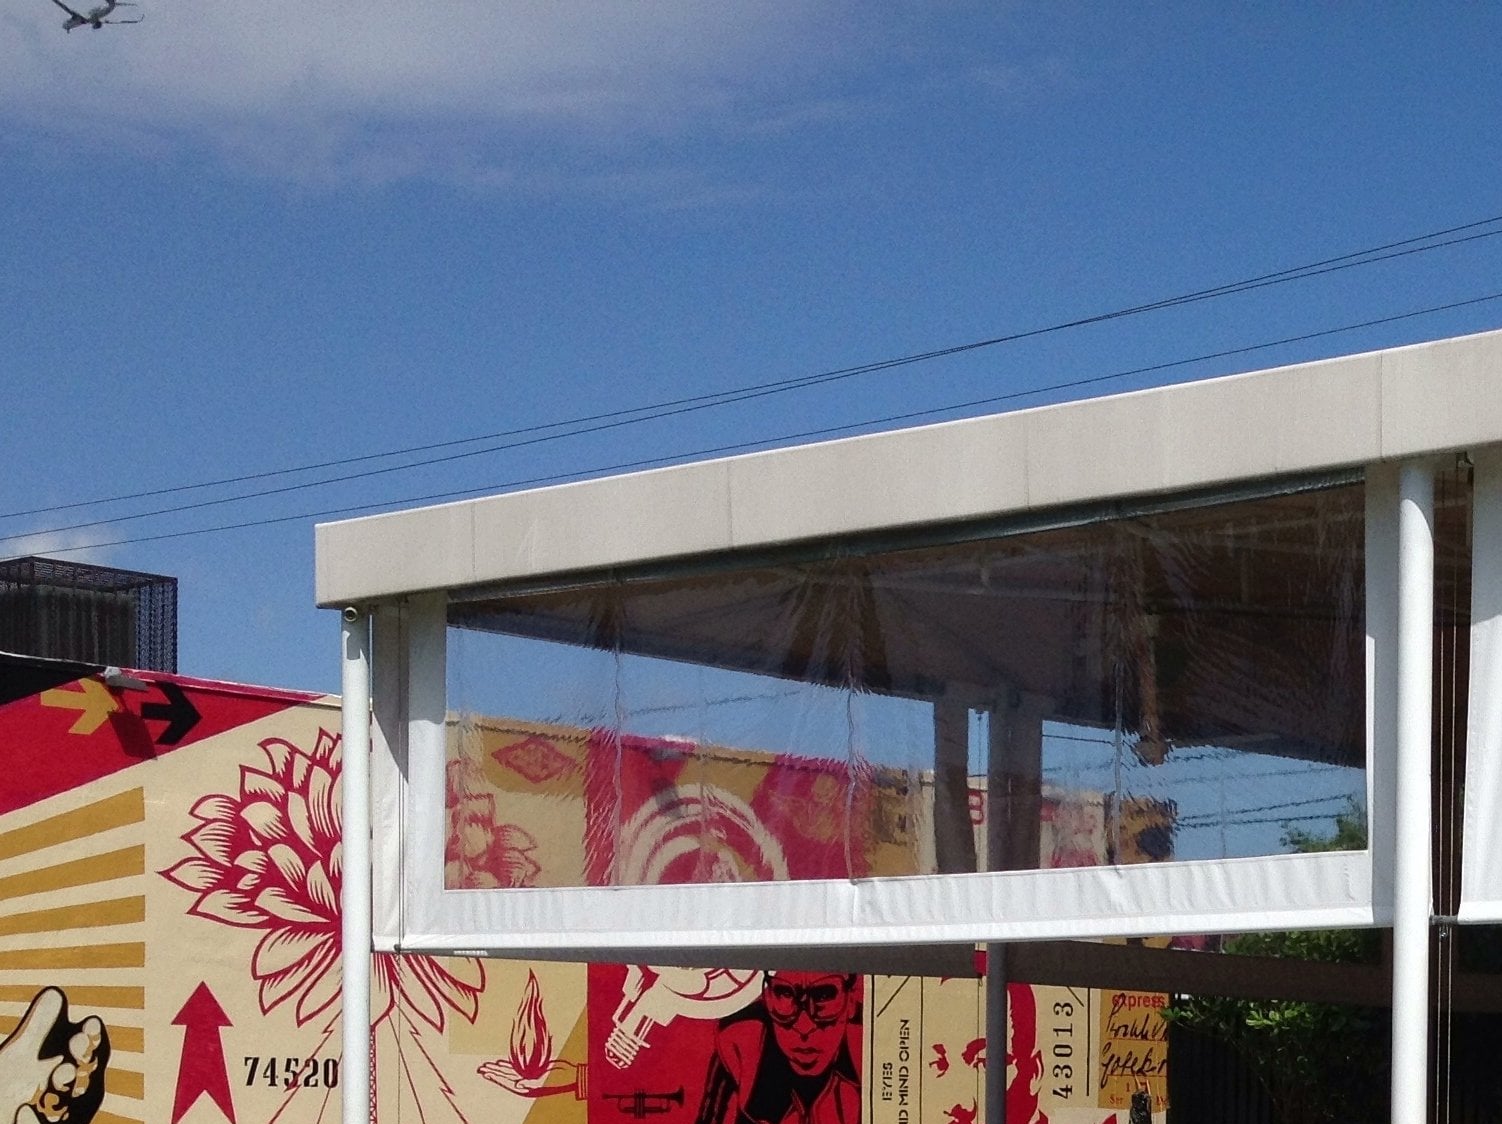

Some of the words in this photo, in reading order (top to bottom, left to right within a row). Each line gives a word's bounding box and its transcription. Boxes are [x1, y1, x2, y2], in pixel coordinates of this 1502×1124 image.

[899, 1018, 911, 1062] OPEN
[1052, 1001, 1074, 1099] 43013
[244, 1056, 339, 1089] 74520
[882, 1061, 893, 1101] EYES
[898, 1067, 910, 1103] MIND
